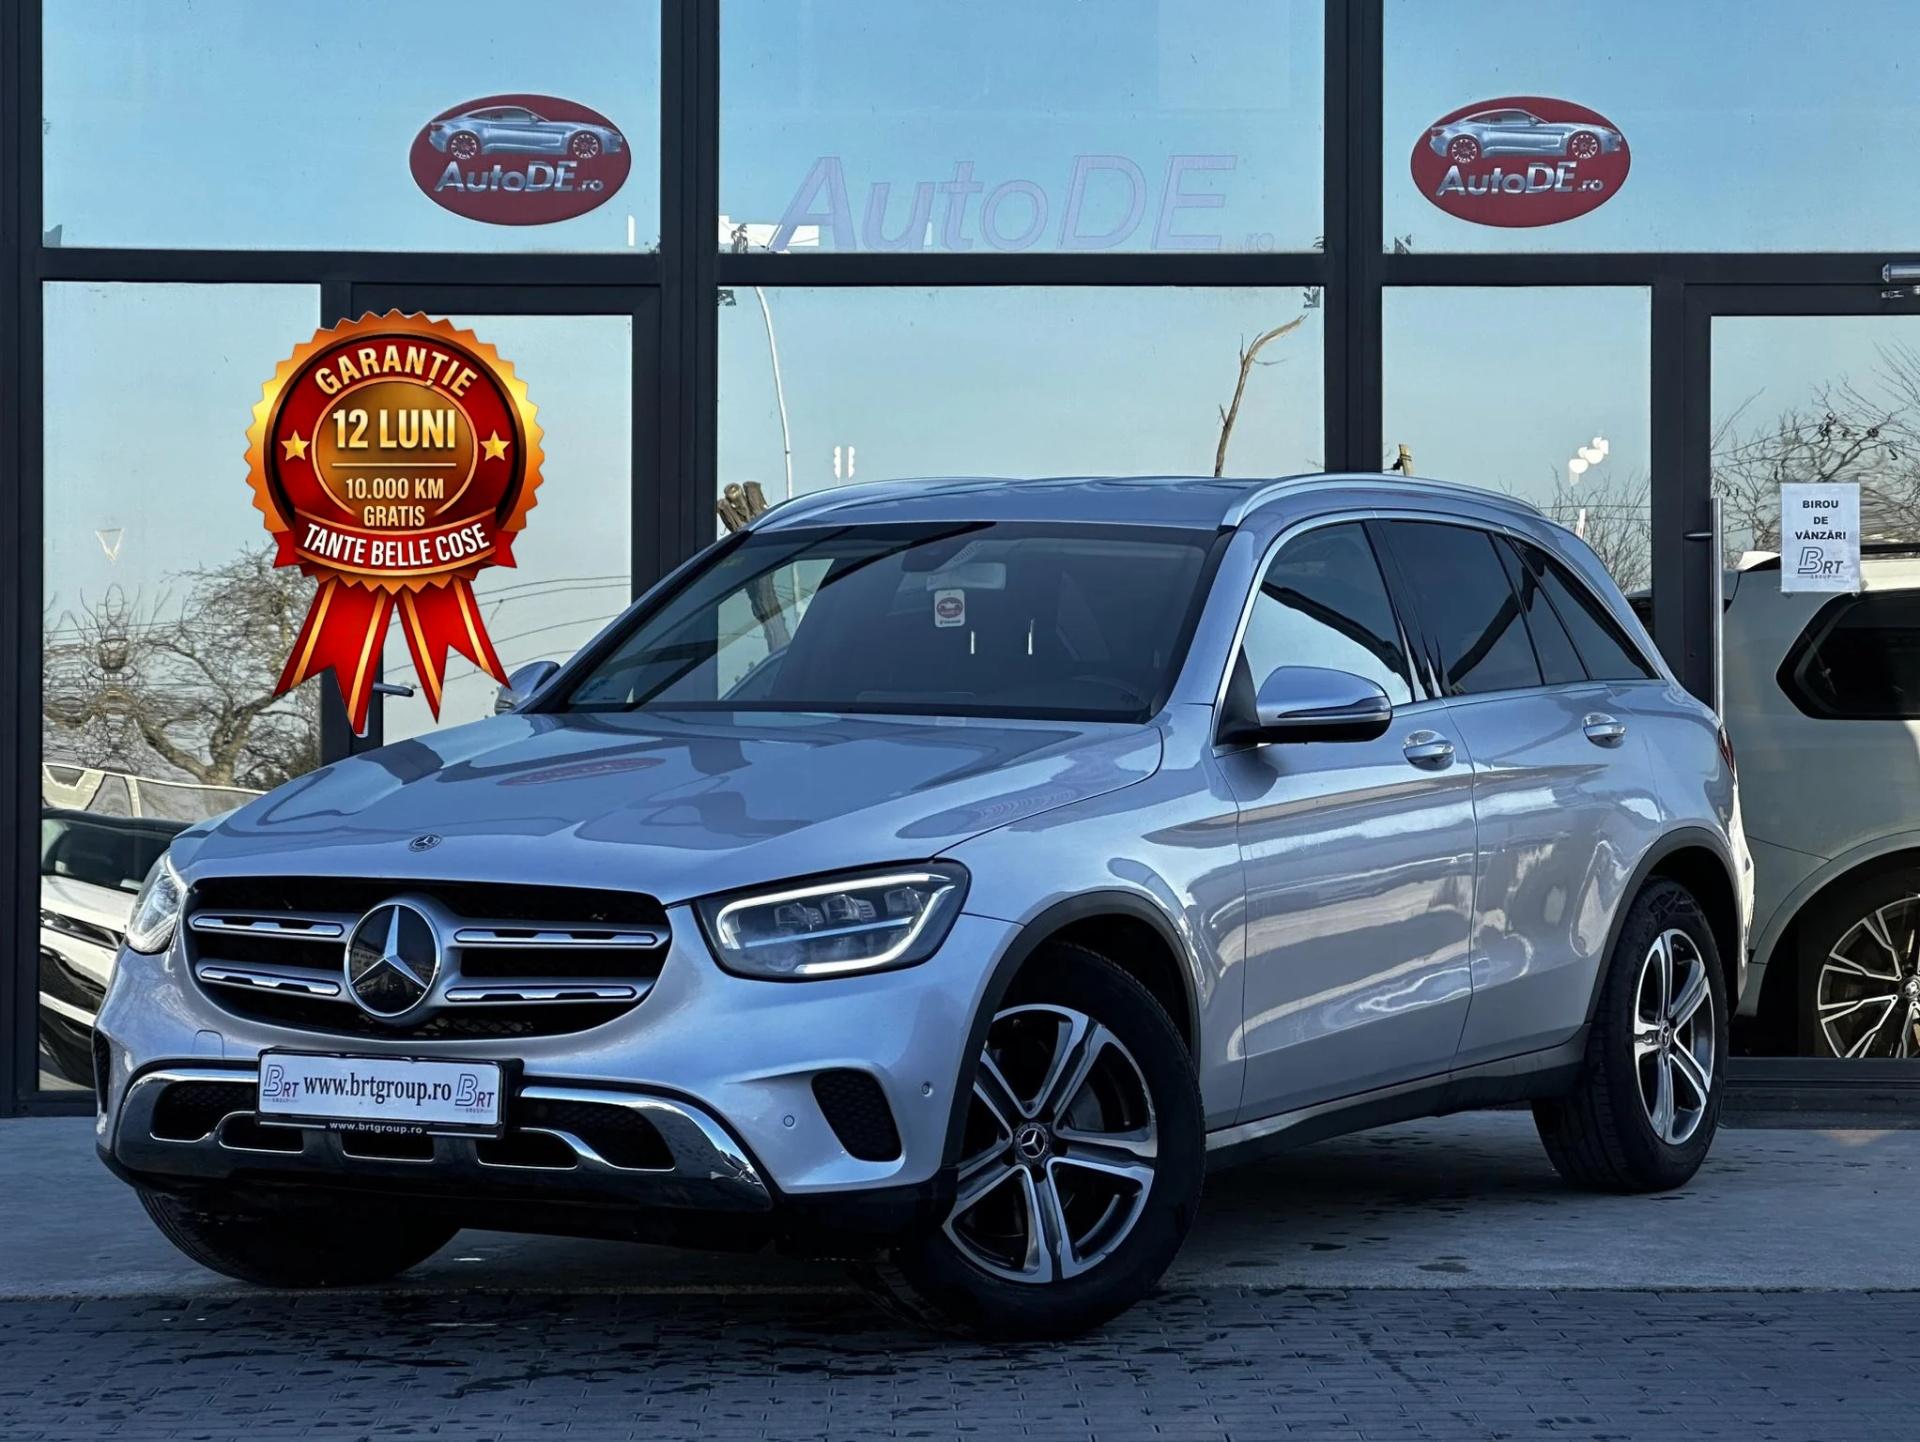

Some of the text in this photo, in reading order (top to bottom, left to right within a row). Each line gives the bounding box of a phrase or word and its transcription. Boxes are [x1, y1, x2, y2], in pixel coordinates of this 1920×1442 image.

[1802, 500, 1839, 509] BIROU
[1813, 516, 1829, 525] DE
[1797, 546, 1844, 575] BRT
[303, 1072, 452, 1106] www.brtgroup.ro
[329, 1121, 423, 1135] www.brtgroup.ro
